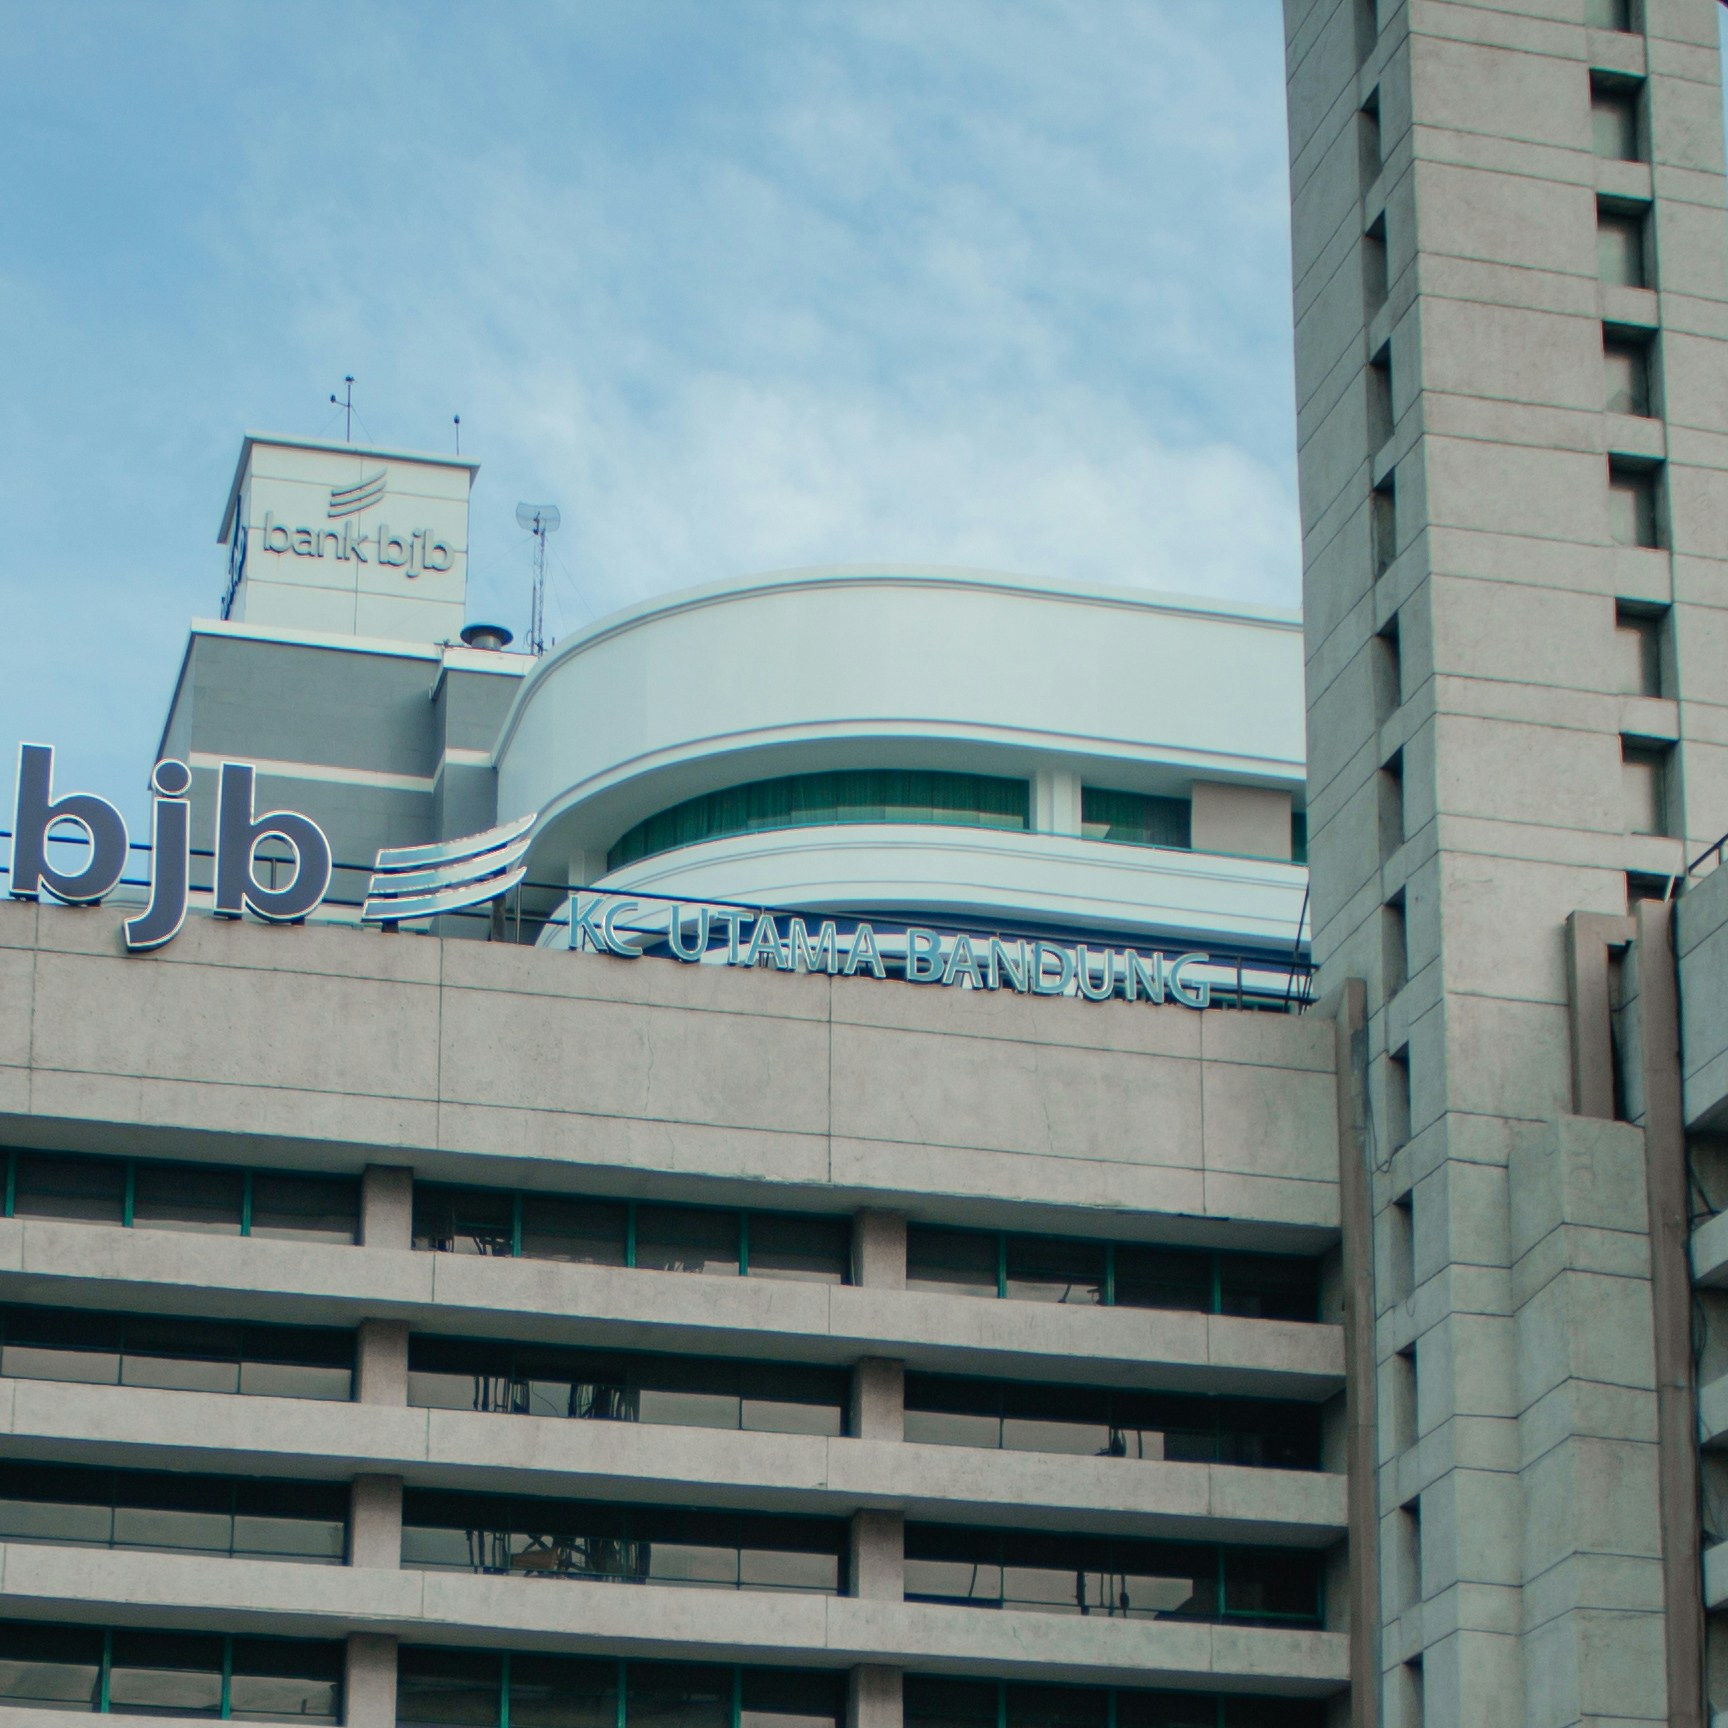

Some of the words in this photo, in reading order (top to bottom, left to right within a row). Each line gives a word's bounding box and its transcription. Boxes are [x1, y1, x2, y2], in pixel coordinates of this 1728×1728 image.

[262, 510, 369, 563] bank
[377, 522, 455, 578] bjb
[9, 743, 333, 952] bjb
[568, 892, 644, 958] KC
[669, 902, 886, 979] UTAMA
[906, 929, 1211, 1009] BANDUNG
